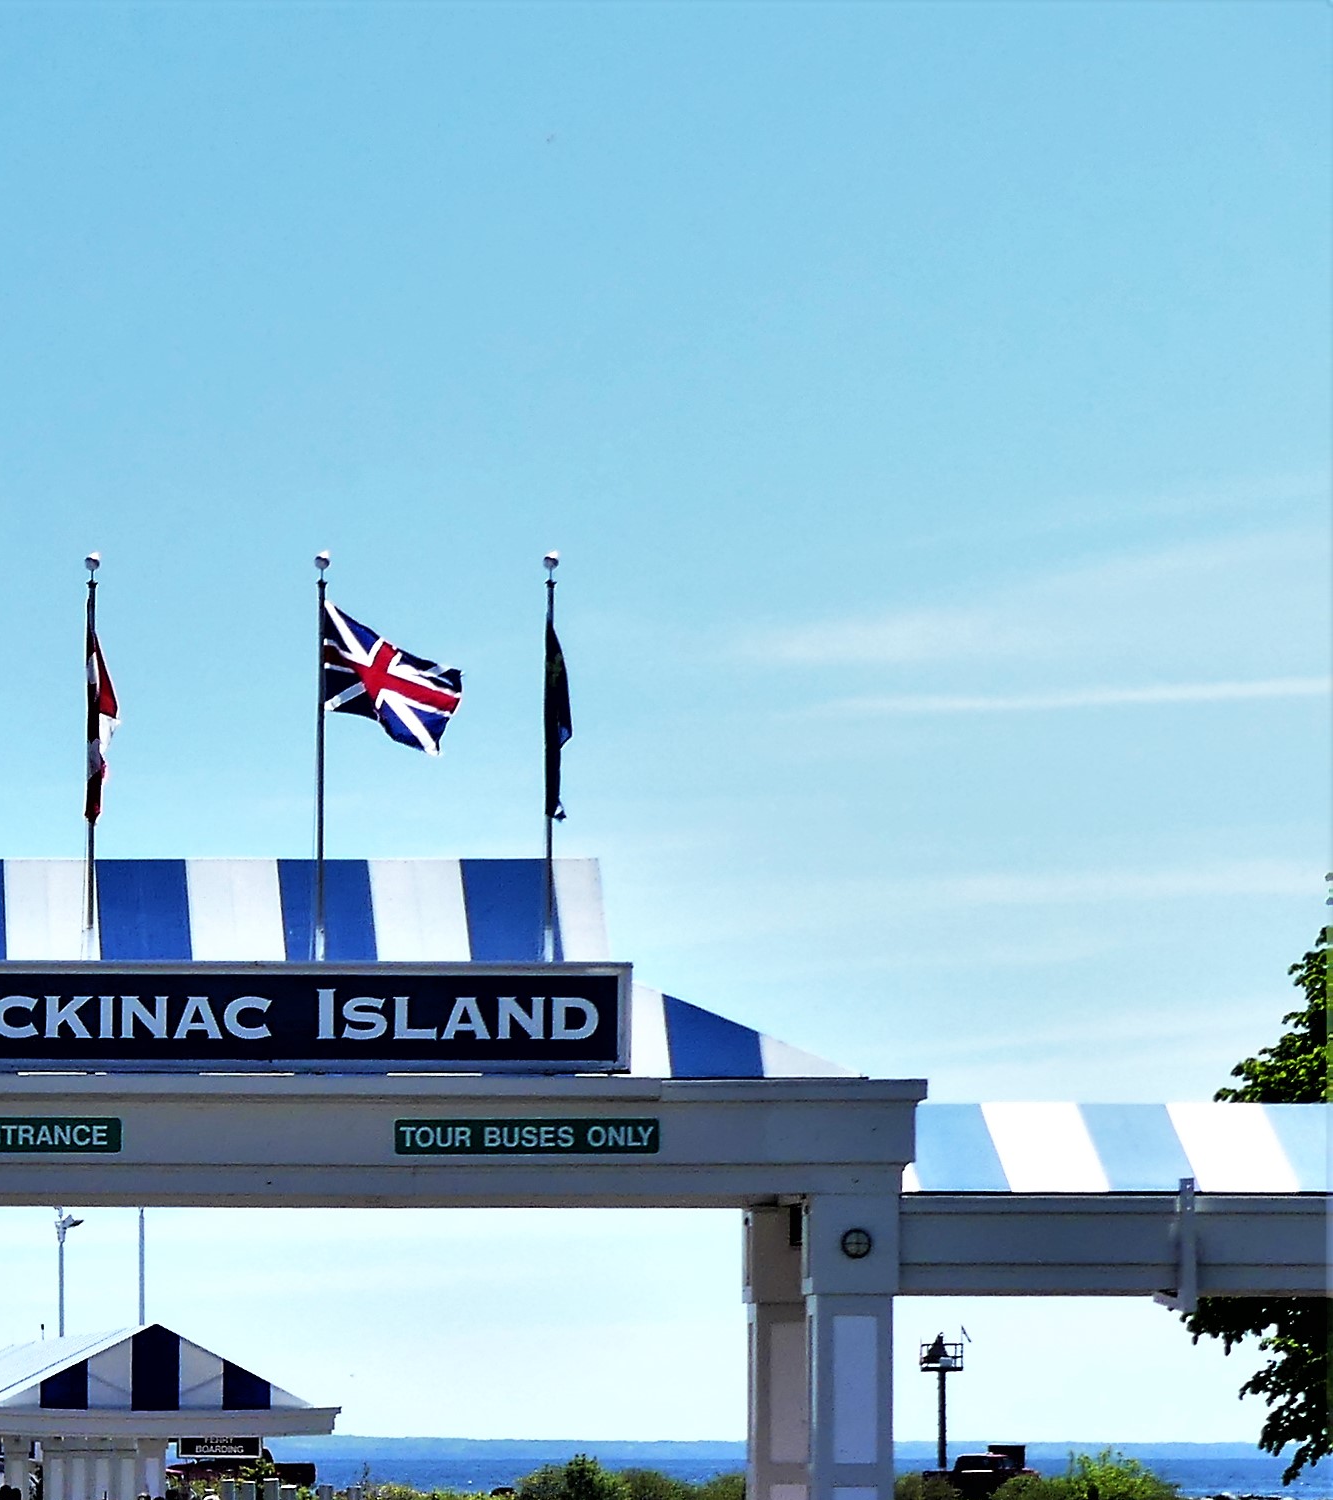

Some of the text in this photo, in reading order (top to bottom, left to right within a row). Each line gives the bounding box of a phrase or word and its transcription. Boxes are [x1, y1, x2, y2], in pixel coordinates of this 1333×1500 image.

[316, 988, 599, 1041] ISLAND
[399, 1125, 654, 1148] TOUR BUSES ONLY
[195, 1445, 244, 1454] BOARDING
